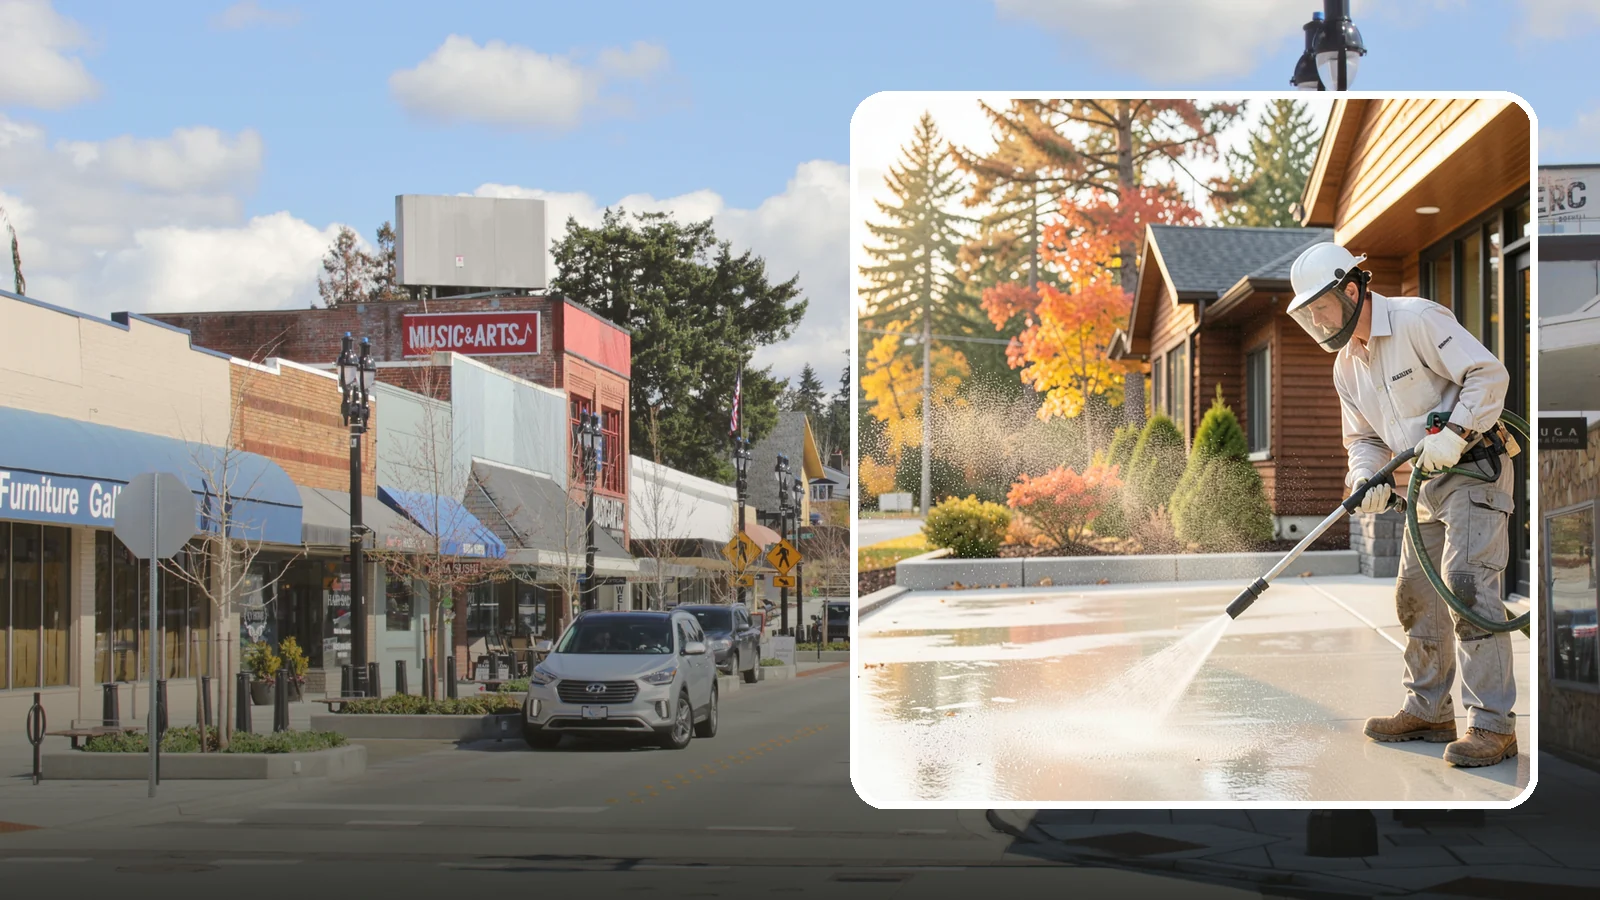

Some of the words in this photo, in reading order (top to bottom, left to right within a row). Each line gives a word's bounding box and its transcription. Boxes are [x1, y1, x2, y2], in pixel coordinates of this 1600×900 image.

[409, 322, 519, 349] MUSIC&ARTS
[0, 471, 79, 515] Furniture
[89, 482, 121, 519] Gal
